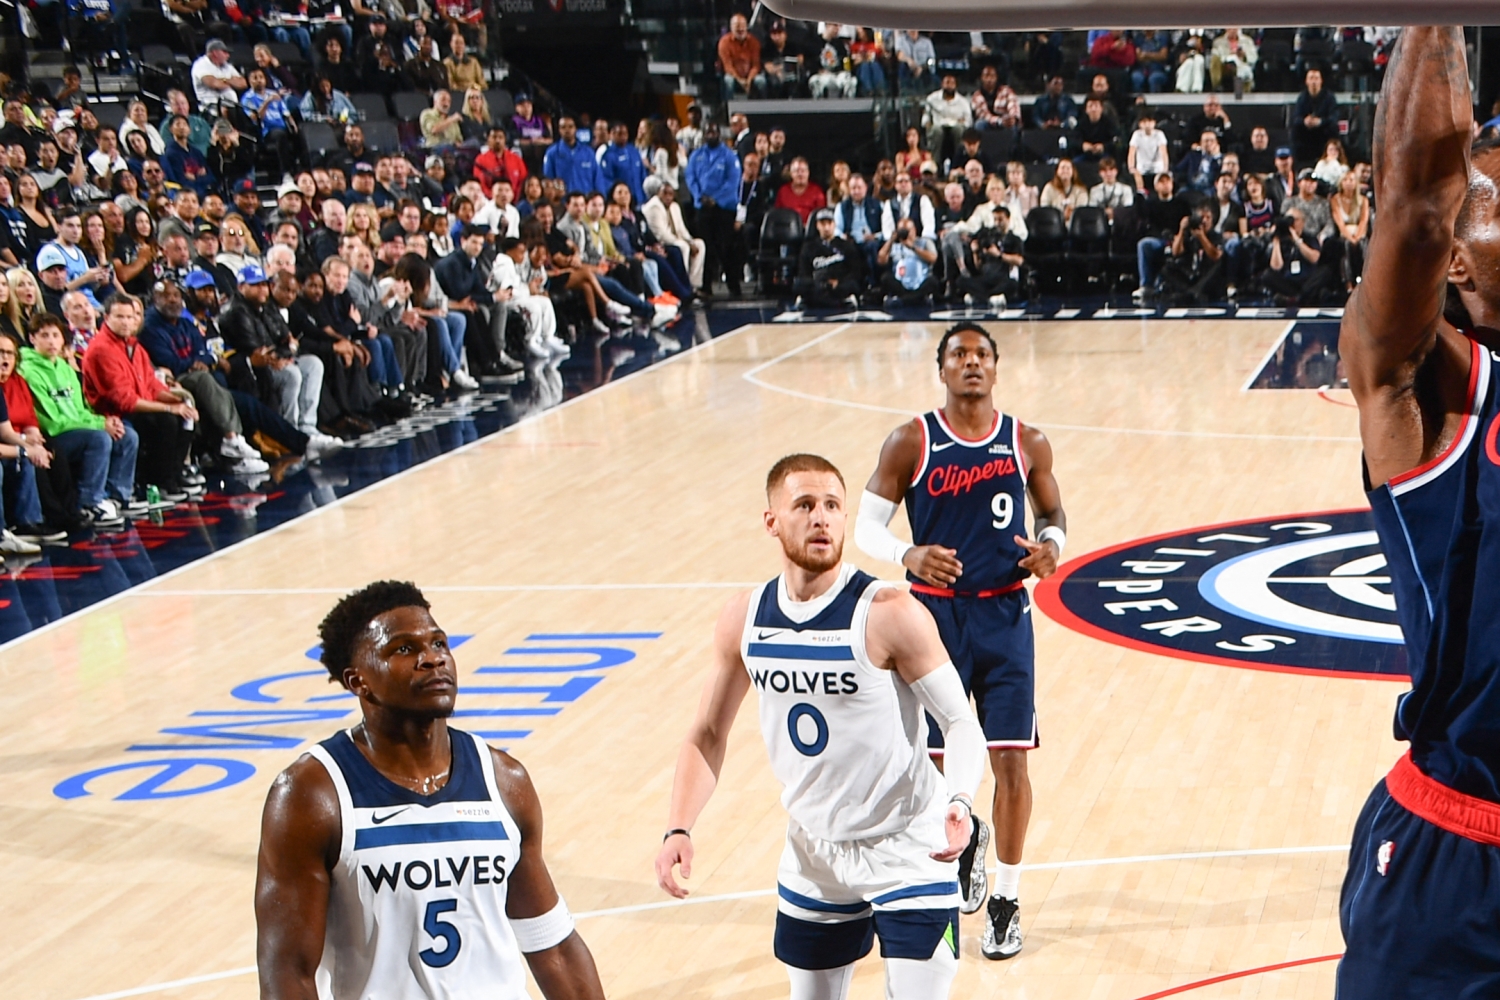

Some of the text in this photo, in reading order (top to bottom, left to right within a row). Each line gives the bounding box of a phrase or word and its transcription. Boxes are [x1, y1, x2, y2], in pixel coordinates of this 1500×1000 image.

[929, 306, 1345, 320] CLIPPER
[927, 456, 1016, 497] Clippers
[991, 492, 1015, 530] 9
[1098, 521, 1333, 653] CLIPPERS
[749, 668, 859, 695] WOLVES
[787, 702, 830, 757] 0
[361, 855, 506, 894] WOLVES
[418, 898, 462, 968] 5
